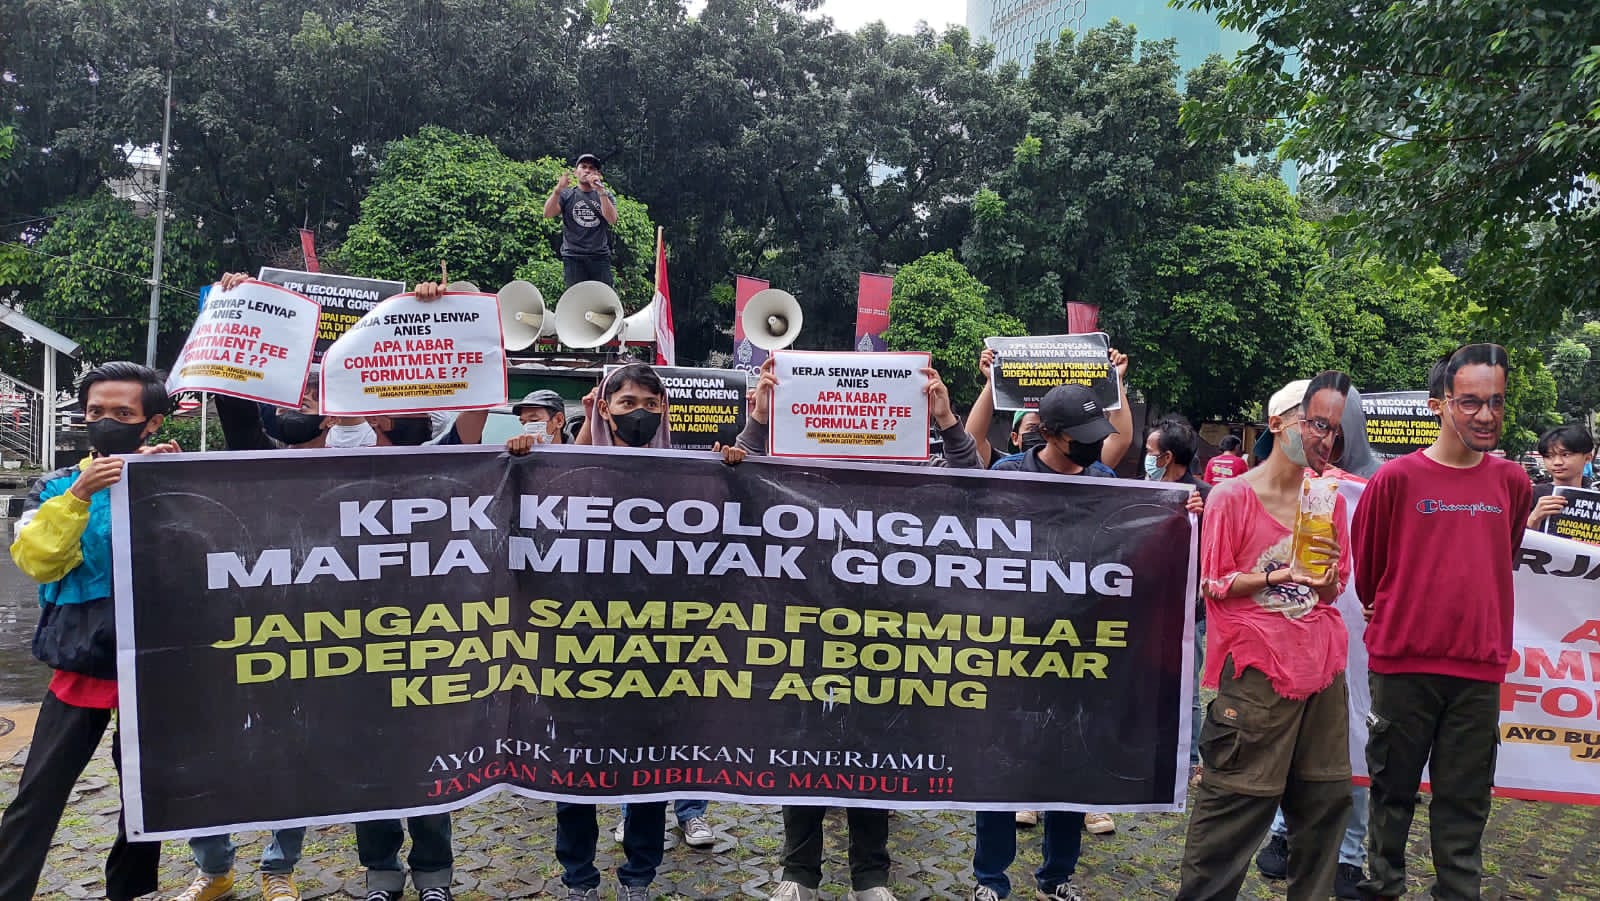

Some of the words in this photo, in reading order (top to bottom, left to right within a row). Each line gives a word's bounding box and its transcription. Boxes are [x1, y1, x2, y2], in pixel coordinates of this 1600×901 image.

[283, 281, 304, 292] KPK
[306, 283, 380, 301] KECOLONGAN
[248, 300, 297, 319] LENYAP
[347, 299, 379, 312] GORE
[211, 309, 243, 319] ANIES
[355, 316, 380, 329] RJA
[383, 313, 431, 325] SENYAP
[434, 312, 480, 323] LENYAP
[214, 322, 262, 339] KABAR
[319, 322, 333, 331] ATA
[394, 325, 432, 336] ANIES
[260, 342, 289, 359] FEE
[373, 340, 403, 353] APA
[406, 338, 454, 351] KABAR
[234, 352, 245, 363] E
[249, 355, 268, 368] ??
[344, 352, 454, 370] COMMITMENT
[457, 351, 483, 364] FEE
[1034, 362, 1063, 370] SAMPAI
[1064, 362, 1102, 370] FORMULA
[360, 367, 435, 383] FORMULA
[438, 367, 447, 379] E
[451, 366, 468, 379] ??
[792, 366, 825, 377] KERJA
[828, 367, 869, 378] SENYAP
[871, 368, 912, 379] LENYAP
[660, 377, 724, 388] ECOLONGAN
[836, 378, 869, 388] ANIES
[1019, 378, 1062, 386] KEJAKSAAN
[666, 388, 692, 399] NYAK
[695, 389, 739, 400] GORENG
[817, 391, 843, 403] APA
[845, 392, 887, 404] KABAR
[669, 404, 687, 413] MPAI
[689, 405, 731, 414] FORMULA
[733, 406, 739, 414] E
[1376, 399, 1428, 407] KECOLONG
[791, 403, 886, 417] COMMITMENT
[888, 406, 912, 418] FEE
[1362, 407, 1376, 415] FIA
[1377, 406, 1413, 415] MINYAK
[669, 414, 682, 423] ATA
[684, 414, 692, 423] DI
[694, 415, 736, 424] BONGKAR
[805, 417, 868, 430] FORMULA
[871, 418, 879, 430] E
[882, 419, 897, 431] ??
[1380, 420, 1410, 428] SAMPAI
[1411, 421, 1440, 429] FORMU
[688, 424, 719, 433] AGUNG
[1384, 428, 1405, 436] MATA
[1416, 499, 1502, 516] Champion
[1575, 498, 1594, 510] KPK
[1562, 507, 1590, 519] MAFIA
[339, 495, 498, 537] KPK
[519, 494, 1033, 553] KECOLONGAN
[1556, 519, 1591, 531] JANGAN
[1556, 526, 1593, 539] DIDEPAN
[206, 540, 491, 590] MAFIA
[507, 536, 808, 581] MINYAK
[831, 549, 1134, 598] GORENG
[210, 597, 511, 649] JANGAN
[527, 599, 767, 631] SAMPAI
[784, 606, 1083, 647] FORMULA
[1095, 620, 1129, 648] E
[235, 630, 540, 684] DIDEPAN
[554, 634, 729, 664] MATA
[746, 636, 806, 668] DI
[822, 639, 1109, 680] BONGKAR
[390, 664, 753, 707] KEJAKSAAN
[769, 674, 988, 710] AGUNG
[1506, 726, 1556, 741] AYO
[428, 745, 485, 773] AYO
[494, 737, 551, 763] KPK
[563, 745, 755, 766] TUNJUKKAN
[768, 748, 954, 774] KINERJAMU,
[427, 760, 537, 798] JANGAN
[549, 769, 620, 790] MAU
[632, 767, 776, 790] DIBILANG
[788, 772, 918, 794] MANDUL
[928, 774, 954, 794] !!!
